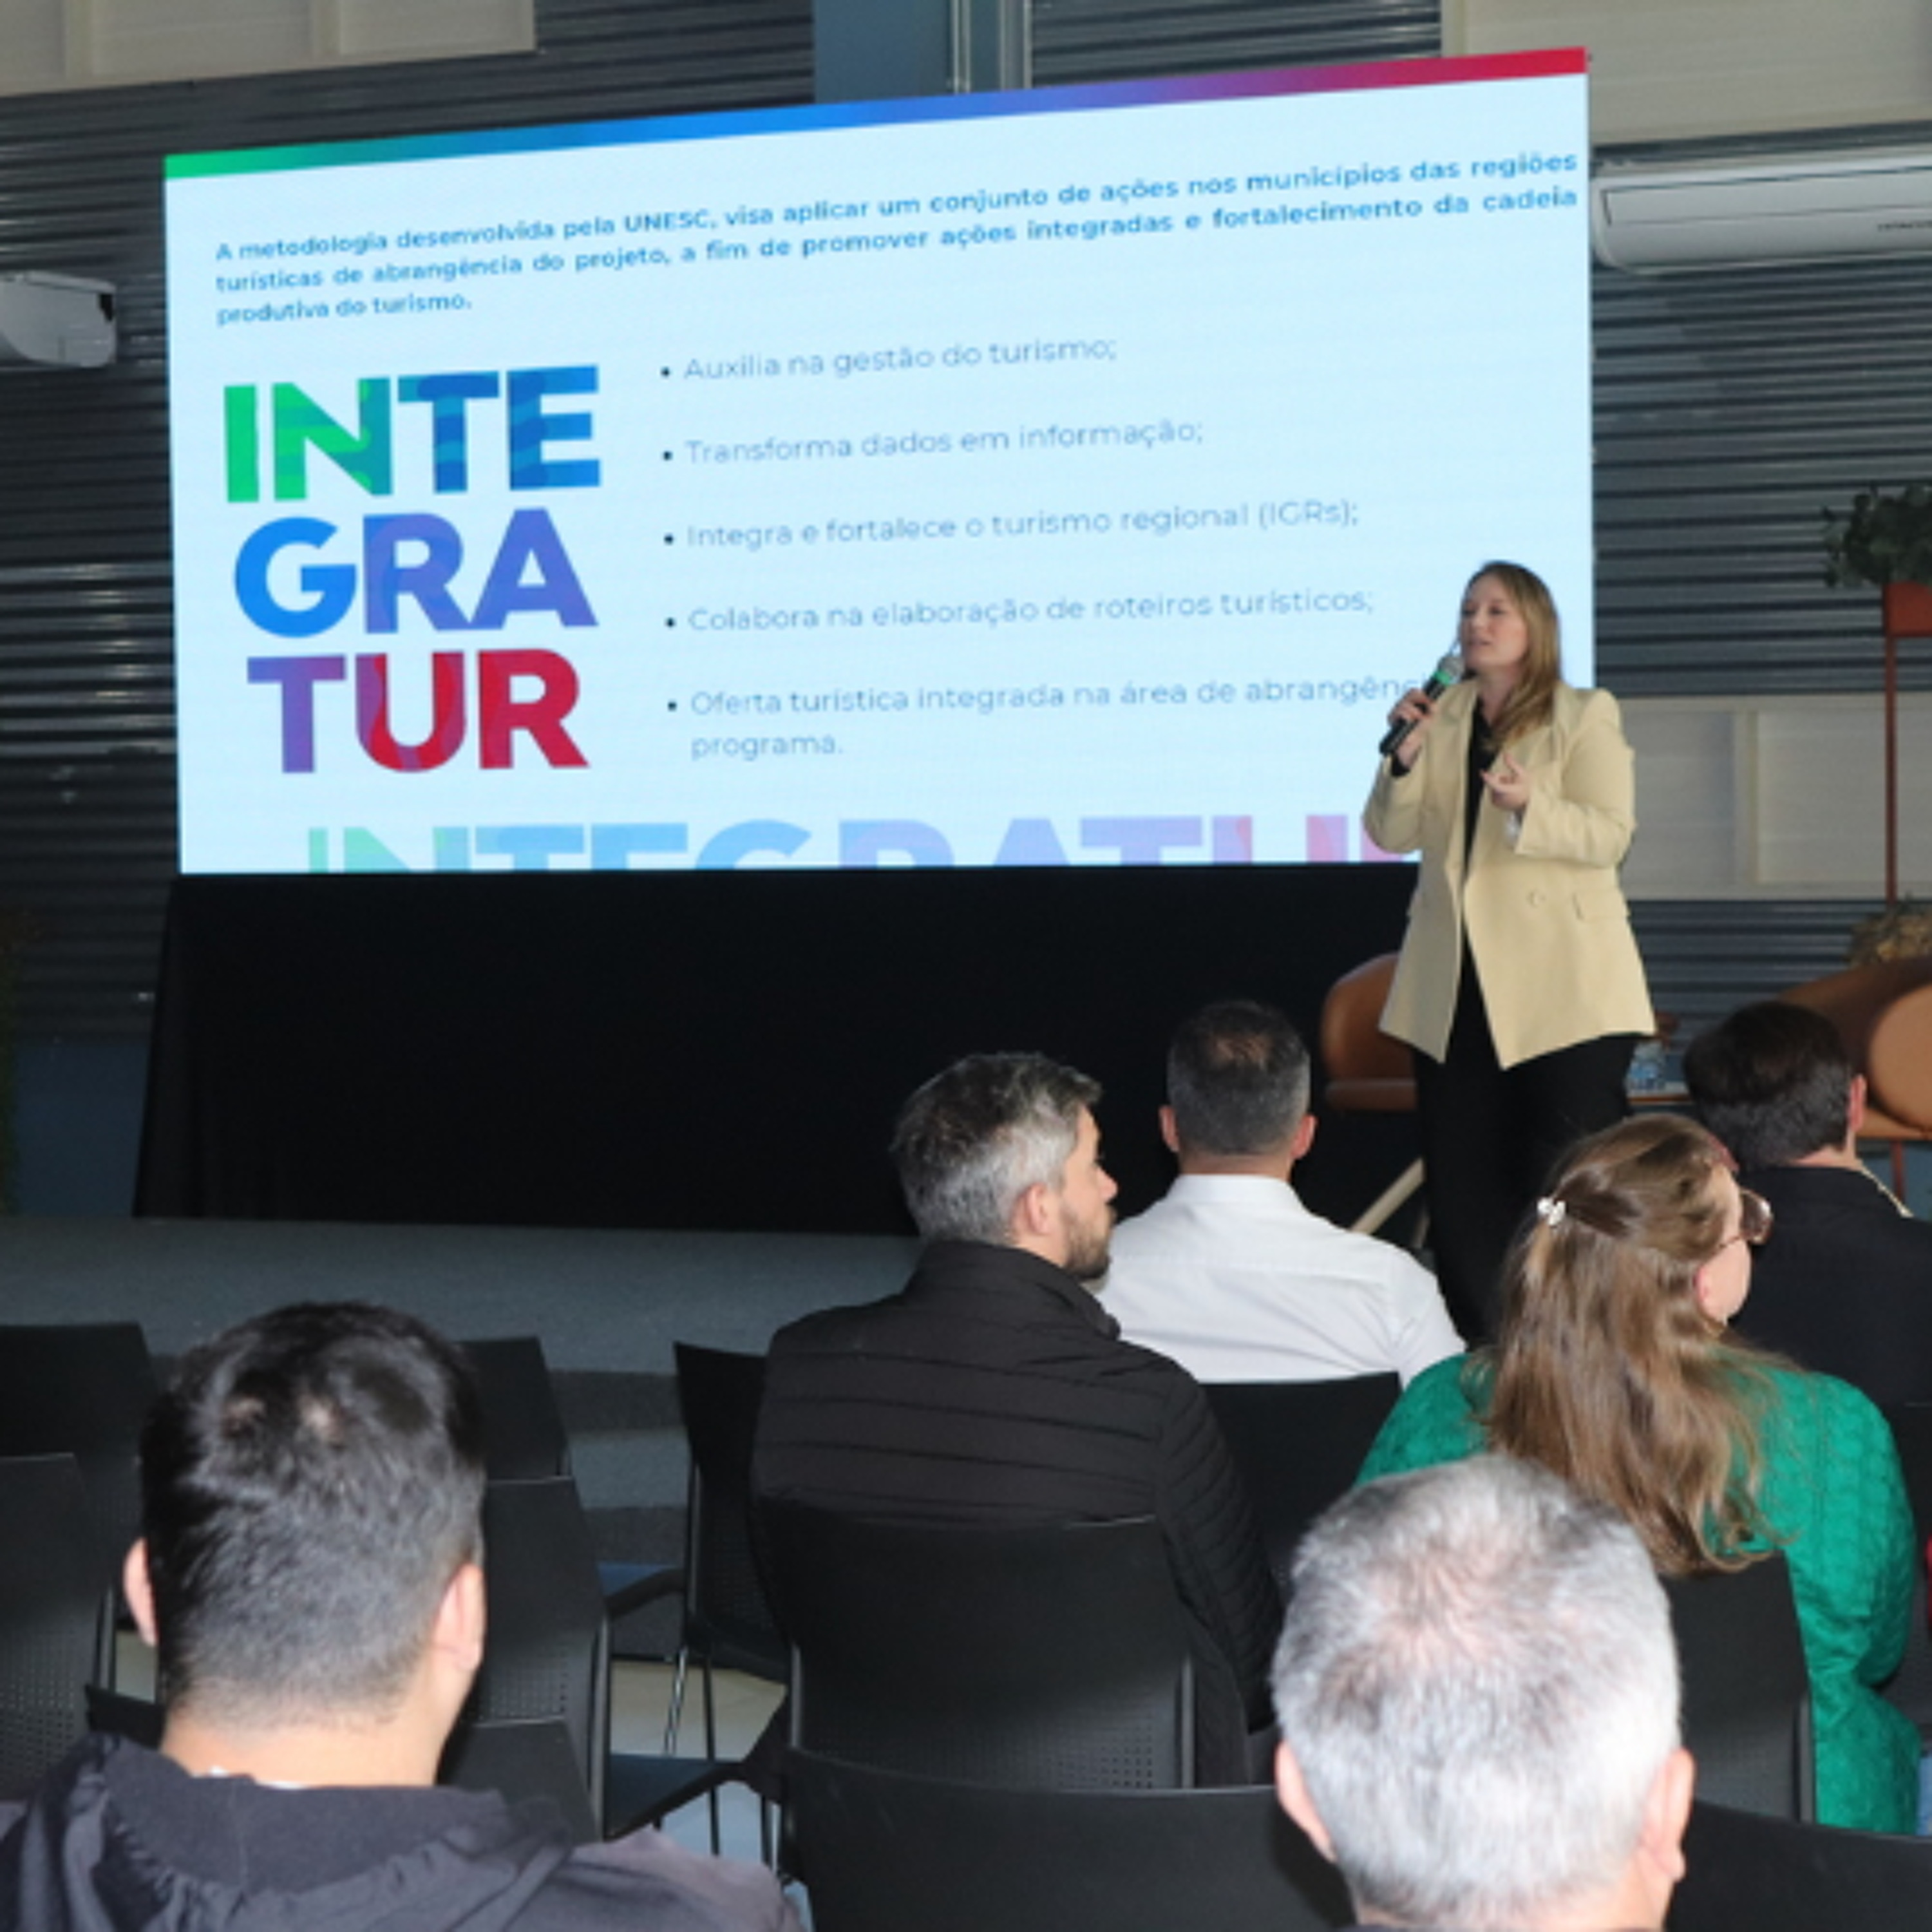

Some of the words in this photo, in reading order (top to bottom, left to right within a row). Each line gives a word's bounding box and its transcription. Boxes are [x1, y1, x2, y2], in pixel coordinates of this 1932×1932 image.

[214, 242, 234, 261] A
[238, 231, 389, 260] metodologia
[395, 220, 556, 249] desenvolvida
[562, 216, 616, 240] pela
[623, 210, 718, 237] UNESC,
[724, 205, 775, 227] visa
[782, 199, 869, 225] aplicar
[877, 198, 922, 217] um
[928, 187, 1049, 214] conjunto
[1057, 184, 1092, 205] de
[1099, 179, 1180, 204] ações
[1188, 176, 1238, 195] nos
[1245, 162, 1403, 192] municípios
[1409, 160, 1462, 182] das
[1470, 153, 1578, 179] regiões
[214, 264, 325, 292] turísticas
[332, 261, 364, 283] de
[370, 250, 524, 283] abrangência
[531, 252, 565, 272] do
[574, 246, 672, 272] projeto,
[680, 245, 697, 262] a
[705, 238, 750, 260] fim
[758, 238, 792, 258] de
[800, 230, 929, 258] promover
[940, 218, 1018, 249] ações
[1027, 214, 1175, 241] integradas
[1183, 214, 1202, 230] e
[1211, 198, 1424, 229] fortalecimento
[1432, 193, 1470, 215] da
[1481, 184, 1578, 212] cadeia
[216, 299, 331, 327] produtiva
[334, 298, 368, 317] do
[371, 289, 472, 314] turismo.
[682, 354, 782, 379] Auxilia
[787, 354, 826, 375] na
[831, 346, 936, 379] gestão
[941, 343, 983, 368] do
[987, 339, 1117, 365] turismo;
[224, 365, 600, 503] INTE
[684, 436, 855, 464] Transforma
[860, 430, 954, 457] dados
[958, 431, 1011, 453] em
[1019, 419, 1203, 450] informação;
[687, 524, 793, 552] Integra
[800, 523, 820, 545] e
[825, 517, 960, 543] fortalece
[965, 516, 985, 538] o
[990, 510, 1112, 536] turismo
[1120, 503, 1249, 536] regional
[234, 507, 599, 638] GRA
[687, 605, 820, 632] Colabora
[826, 606, 864, 627] na
[871, 597, 1040, 628] elaboração
[1045, 598, 1087, 620] de
[1094, 595, 1214, 620] roteiros
[247, 648, 590, 772] TUR
[690, 690, 782, 716] Oferta
[917, 683, 1066, 714] integrada
[1073, 686, 1111, 705] na
[1119, 681, 1188, 705] área
[1196, 682, 1237, 705] de
[690, 734, 843, 762] programa.
